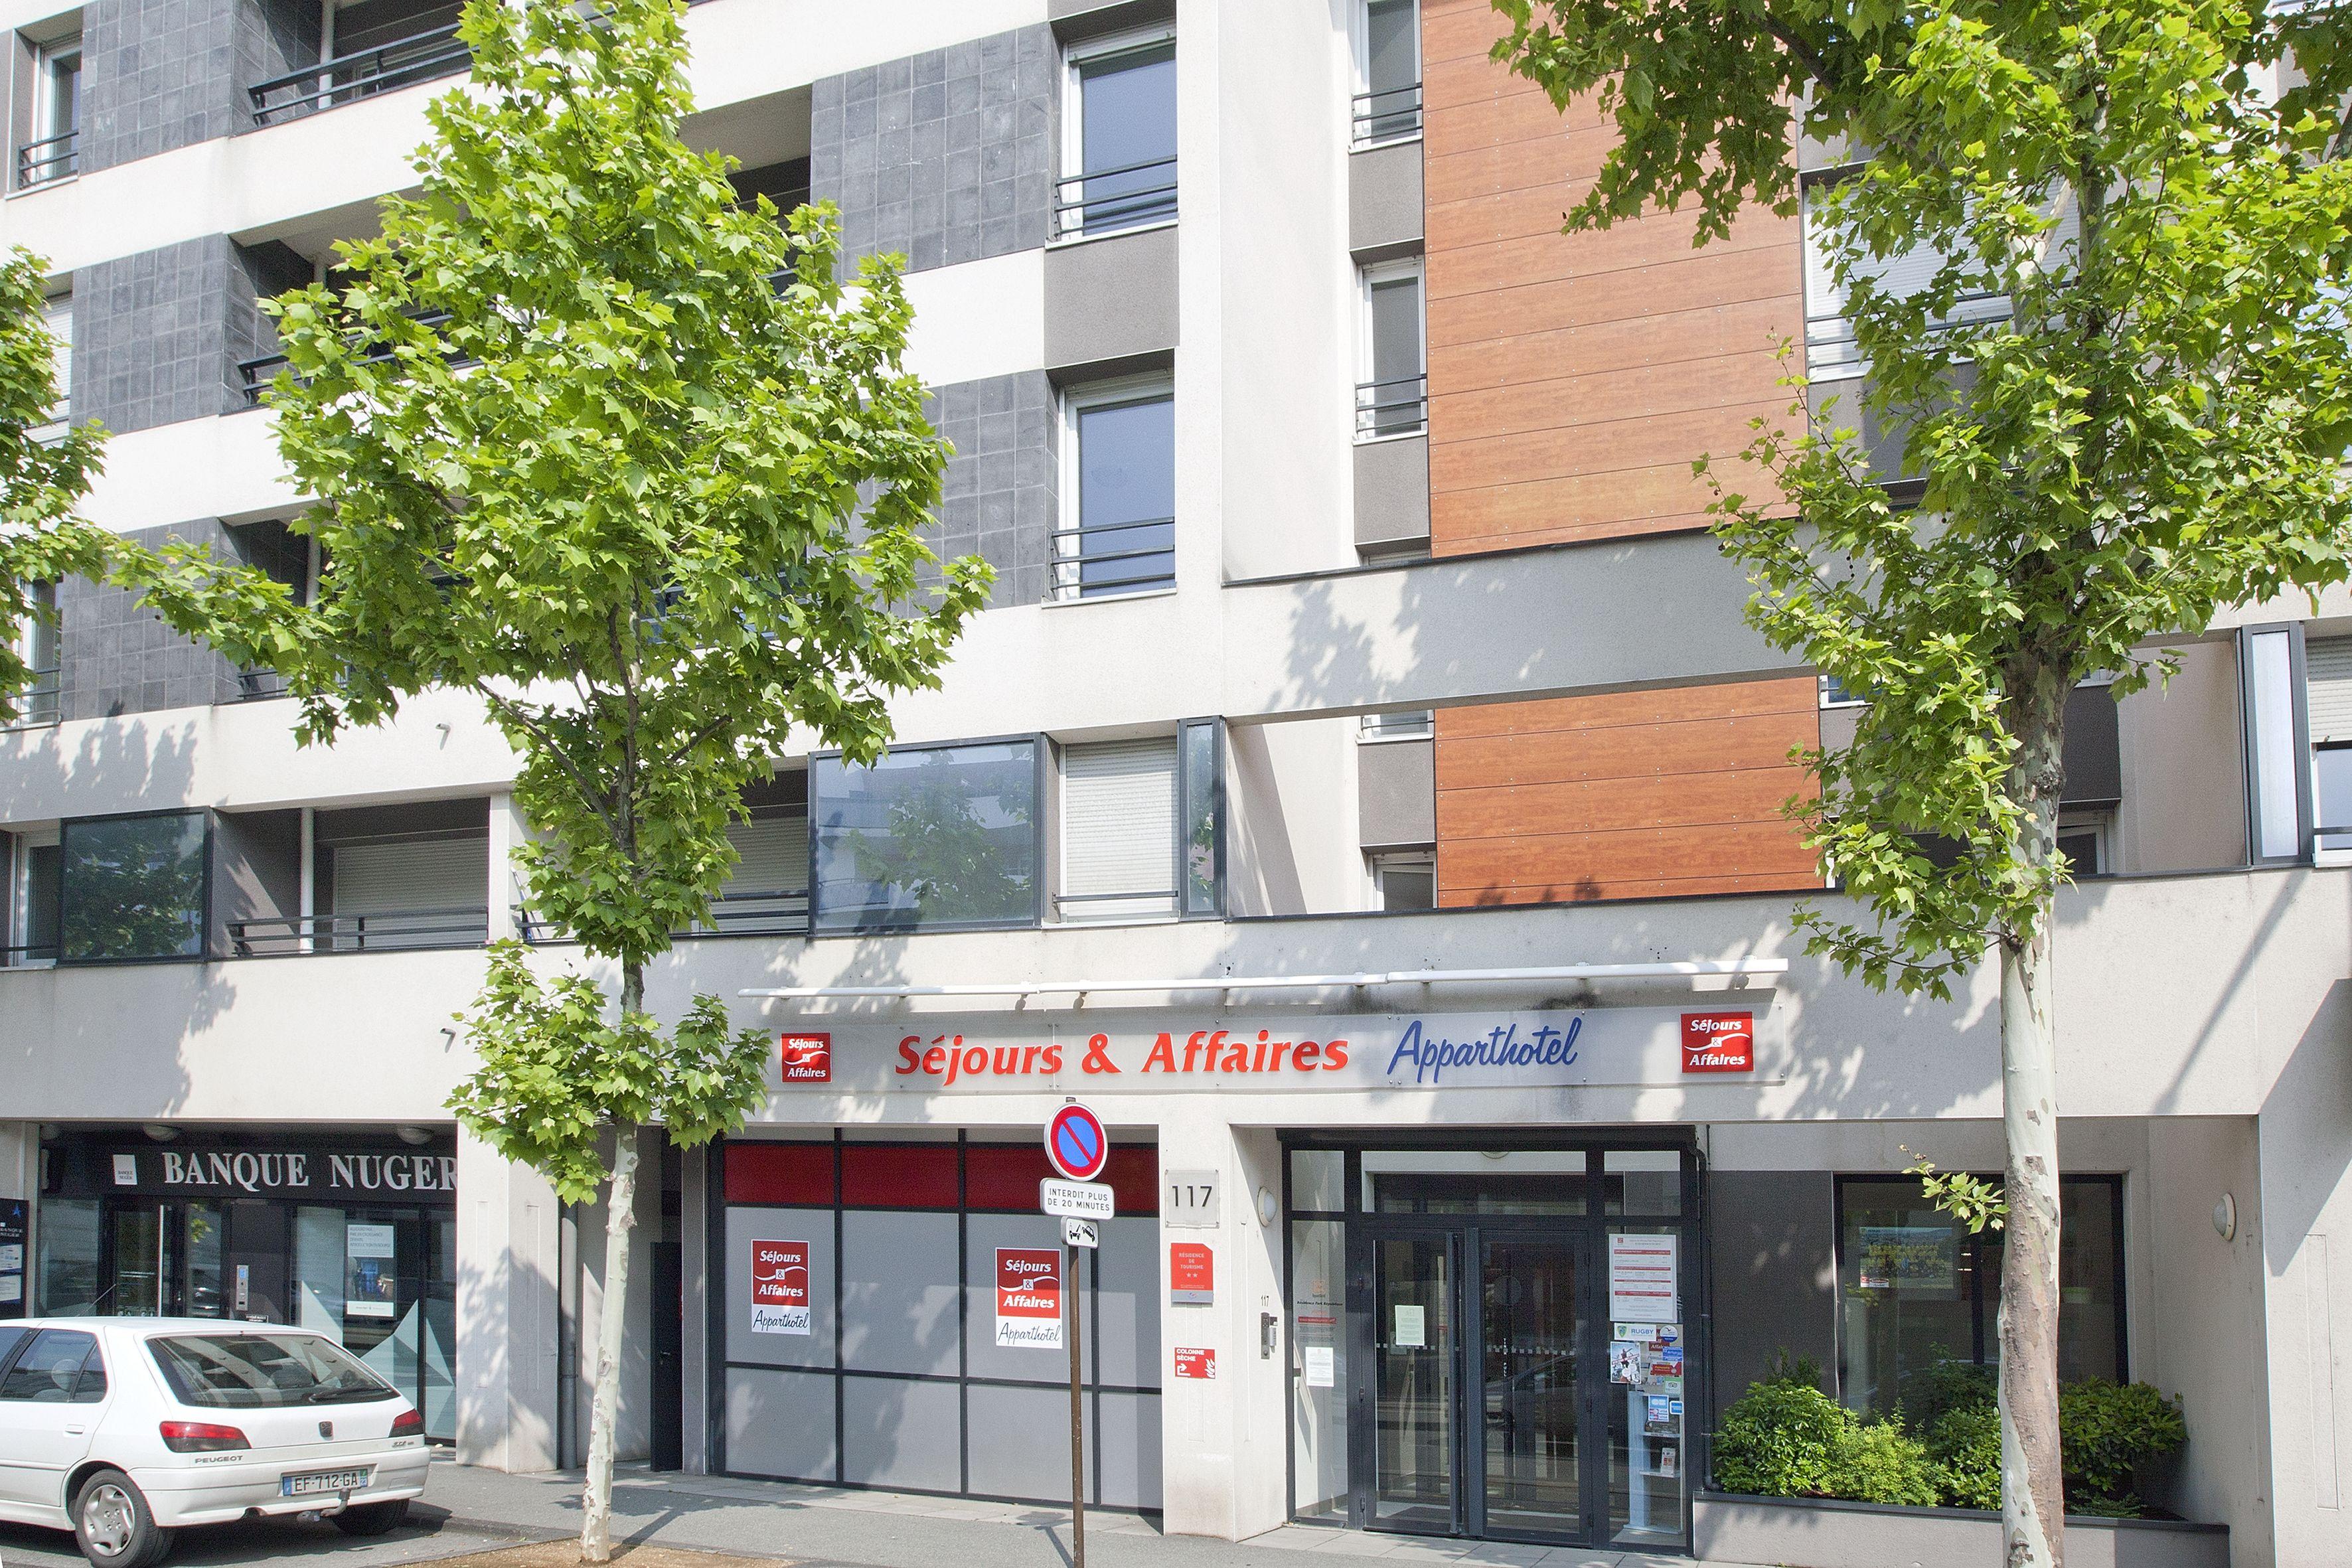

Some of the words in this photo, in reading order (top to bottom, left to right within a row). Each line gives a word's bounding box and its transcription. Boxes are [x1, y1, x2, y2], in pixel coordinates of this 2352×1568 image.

[1689, 1019, 1743, 1032] Séjours
[788, 1038, 824, 1051] Séjours
[894, 1034, 1063, 1087] Séjours
[1081, 1033, 1123, 1074] &
[1140, 1030, 1350, 1073] Affaires
[1387, 1017, 1583, 1083] Apparthotel
[1689, 1054, 1746, 1067] Affaires
[787, 1067, 826, 1077] Affaires
[162, 1152, 309, 1192] BANQUE
[329, 1155, 457, 1190] NUGER
[1049, 1188, 1084, 1199] INTERDIT
[1088, 1192, 1108, 1202] PLUS
[1172, 1186, 1212, 1207] 117
[1076, 1201, 1110, 1212] MINUTES
[759, 1250, 801, 1265] Séjours
[1005, 1259, 1052, 1275] Séjours
[777, 1270, 784, 1279] &
[758, 1284, 803, 1297] Affaires
[1026, 1280, 1032, 1289] &
[1003, 1294, 1055, 1308] Affaires
[753, 1310, 809, 1332] Apparthotel
[998, 1322, 1061, 1346] Apparthotel
[195, 1455, 243, 1464] PEUGEOT
[295, 1472, 358, 1492] EF-712-GA
